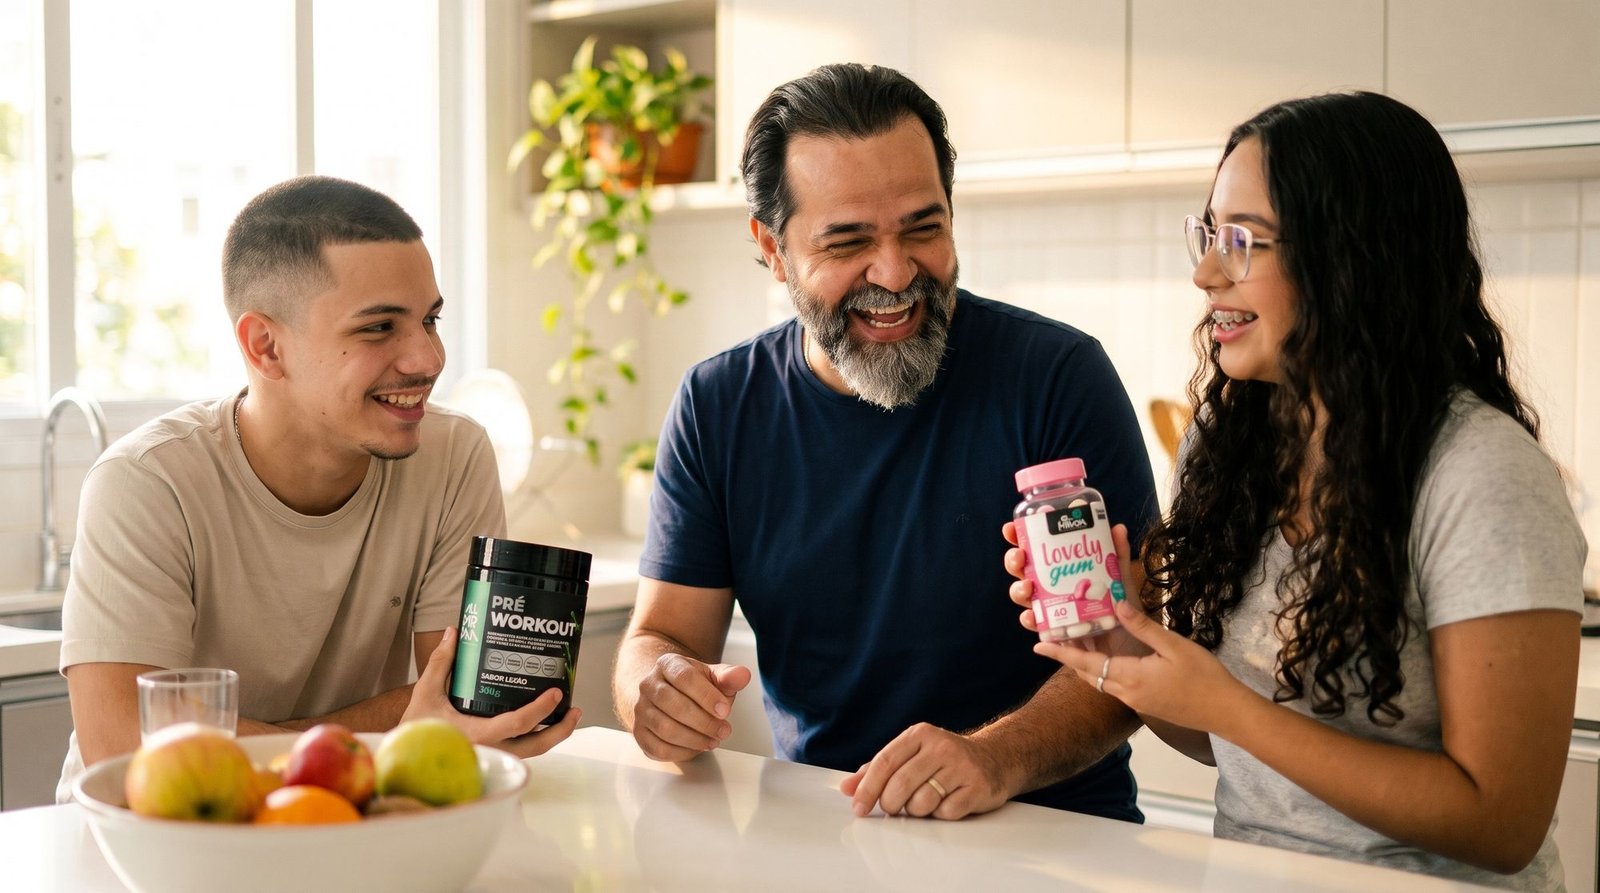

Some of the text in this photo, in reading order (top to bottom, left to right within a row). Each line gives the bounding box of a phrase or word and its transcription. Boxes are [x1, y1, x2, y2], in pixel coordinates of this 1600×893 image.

[1050, 560, 1094, 587] gum
[491, 595, 526, 613] PRÉ
[1054, 607, 1067, 617] 40
[490, 611, 576, 637] WORKOUT
[480, 672, 504, 682] SABOR
